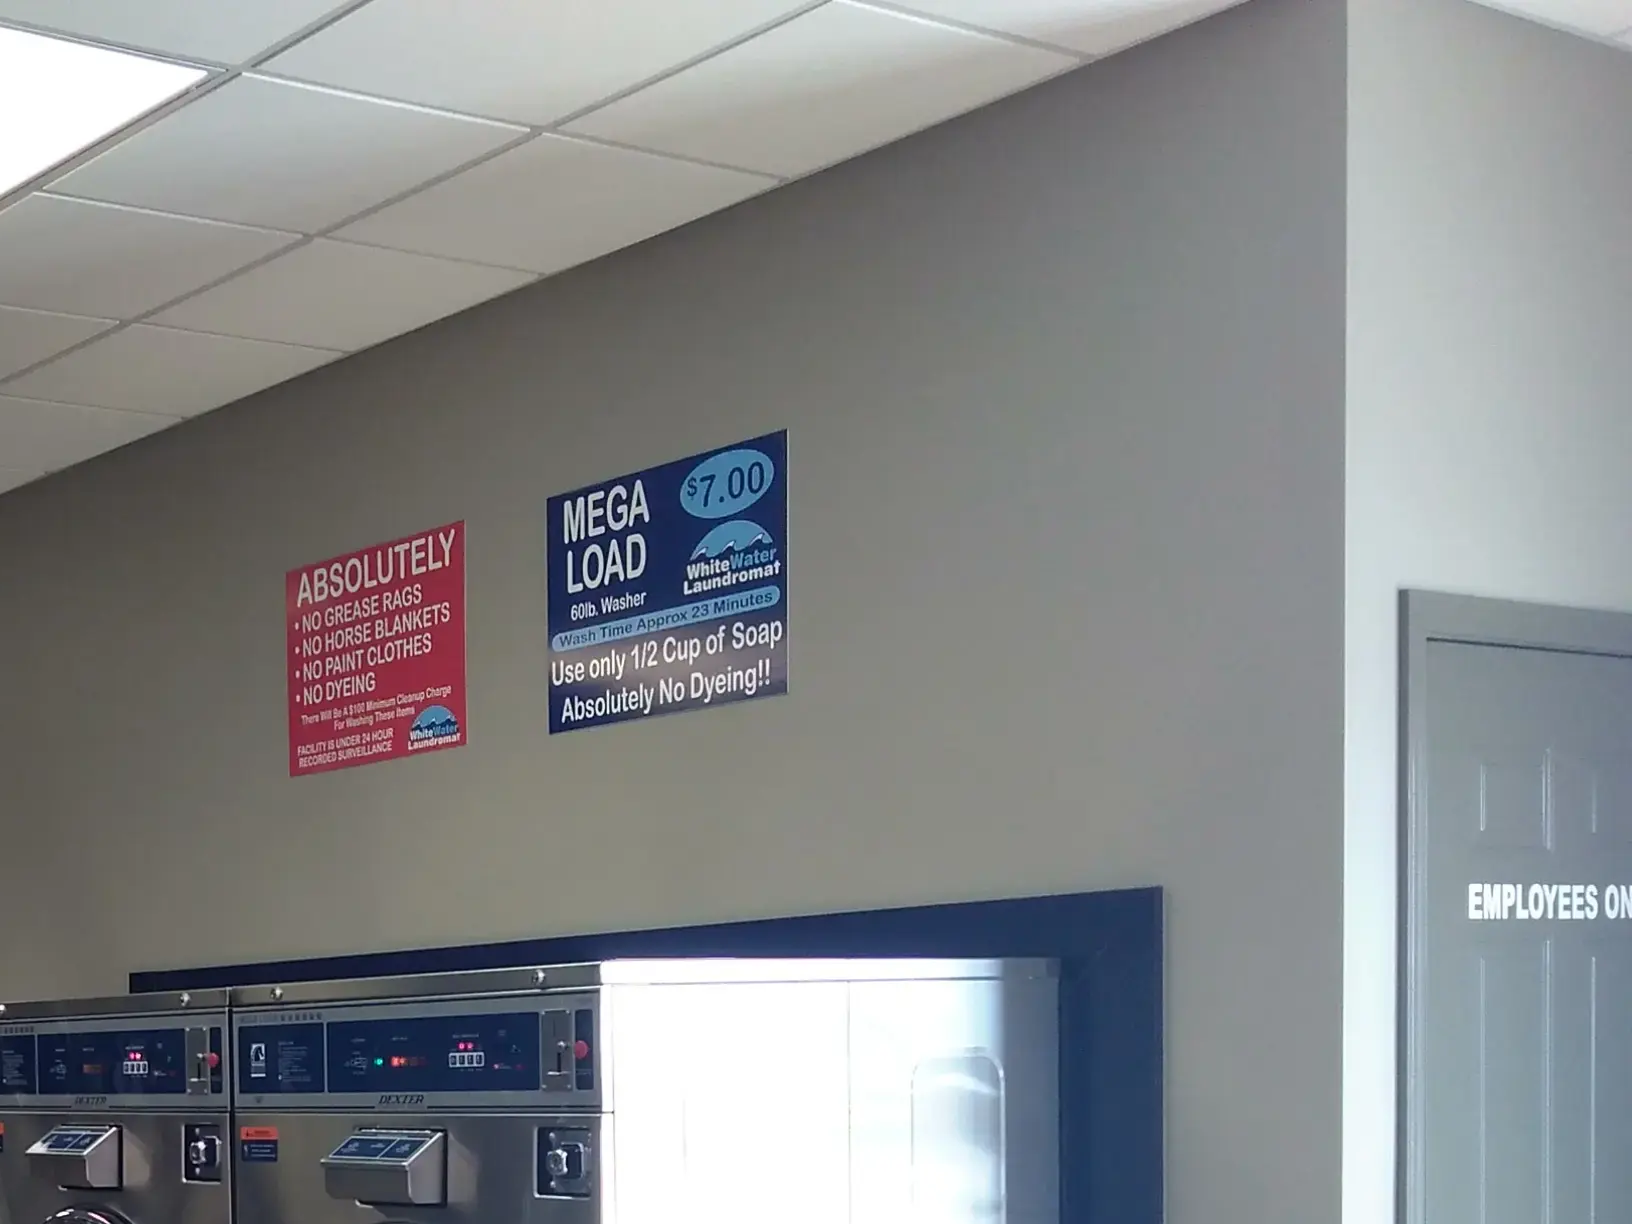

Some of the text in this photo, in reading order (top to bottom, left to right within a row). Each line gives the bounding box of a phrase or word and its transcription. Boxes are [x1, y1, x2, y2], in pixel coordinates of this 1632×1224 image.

[687, 461, 765, 507] $7.00
[563, 479, 650, 544] MEGA
[296, 529, 455, 608] ABSOLUTELY
[567, 533, 647, 594] LOAD
[683, 560, 781, 595] Laundromat
[686, 548, 777, 581] WhiteWater
[302, 583, 422, 634] NO GREASE RAGS
[559, 591, 773, 648] Wash Time Approx 23 Minutes
[570, 590, 647, 621] 60lb. Washer
[303, 602, 450, 658] NO HORSE BLANKETS
[303, 632, 432, 682] NO PAINT CLOTHES
[551, 619, 783, 686] Use only 1/2 Cup of Soap
[301, 714, 319, 725] There
[343, 706, 348, 715] A
[366, 697, 396, 711] Minimum
[396, 691, 425, 704] Cleanup
[426, 685, 451, 698] Charge
[303, 671, 377, 706] NO DYEING
[561, 658, 770, 724] Absolutely No Dyeing!!
[334, 719, 345, 731] For
[346, 715, 374, 728] Washing
[374, 710, 395, 722] These
[297, 741, 326, 756] FACILITY
[328, 739, 335, 750] IS
[335, 734, 361, 749] UNDER
[371, 728, 394, 742] HOUR
[299, 740, 393, 768] RECORDED SURVEILLANCE
[408, 733, 461, 750] Laundromat
[1468, 883, 1599, 920] EMPLOYEES
[378, 1094, 425, 1105] DEXTER
